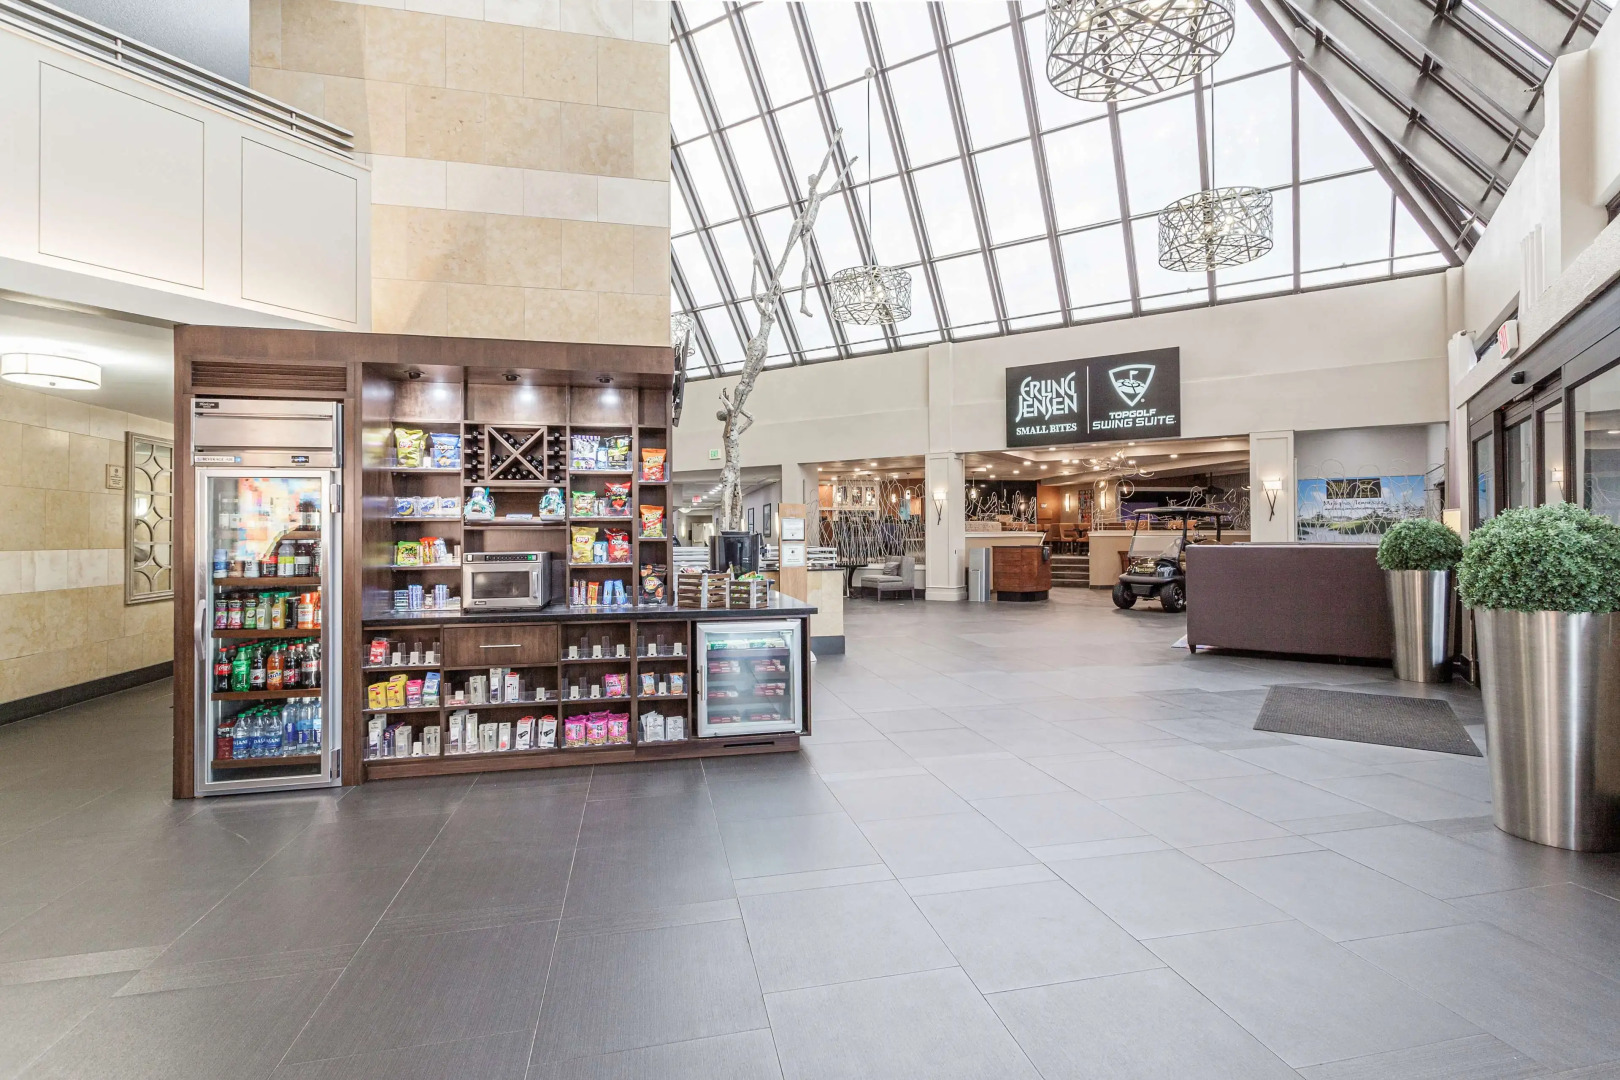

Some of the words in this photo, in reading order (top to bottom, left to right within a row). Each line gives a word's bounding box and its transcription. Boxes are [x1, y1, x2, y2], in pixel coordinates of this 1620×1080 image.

[1015, 393, 1078, 423] JENSEN
[1109, 408, 1157, 419] TOPGOLF
[1016, 425, 1049, 435] SMALL
[1049, 422, 1078, 433] BITES
[1092, 418, 1133, 430] SWING
[1135, 415, 1175, 427] SUITE
